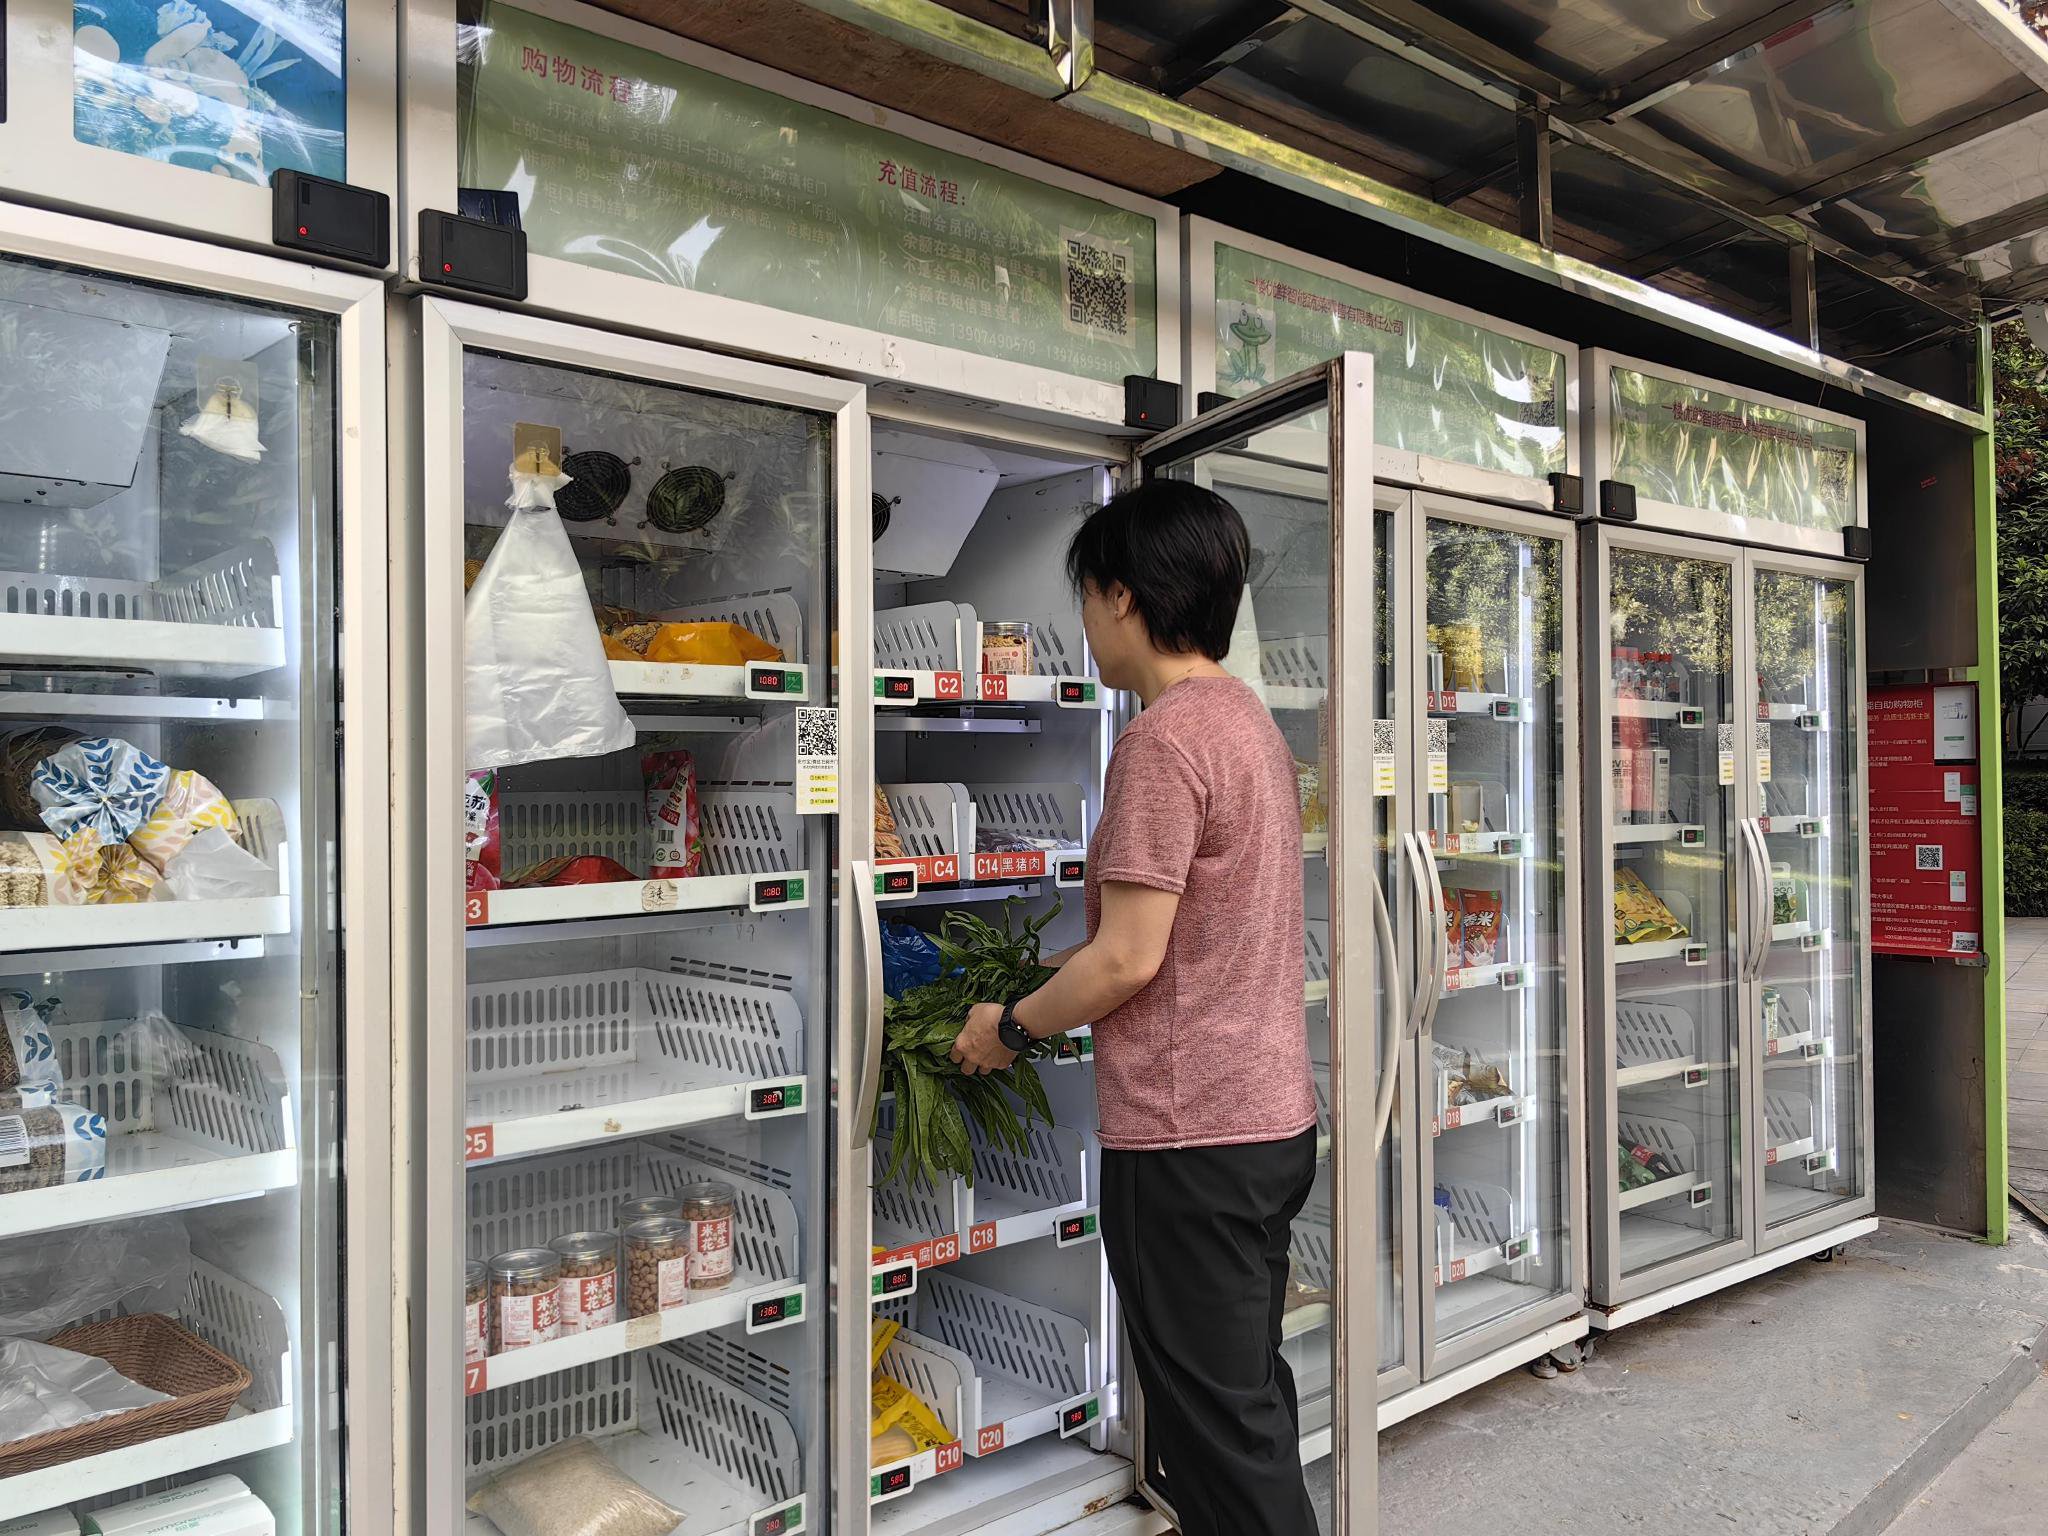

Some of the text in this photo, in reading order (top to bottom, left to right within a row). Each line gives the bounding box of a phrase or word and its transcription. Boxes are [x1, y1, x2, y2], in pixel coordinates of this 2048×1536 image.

[522, 46, 632, 104] 购物流程
[937, 677, 958, 694] C2
[984, 679, 1005, 696] C12
[1442, 696, 1457, 708] D12
[1447, 838, 1459, 850] D14
[934, 860, 955, 877] C4
[977, 857, 1040, 874] C14 黑猪肉
[467, 899, 481, 919] 3
[1447, 1111, 1460, 1125] D18
[973, 1228, 993, 1247] C18
[934, 1240, 956, 1260] C8
[1452, 1263, 1464, 1277] D20
[466, 1367, 479, 1388] 7
[980, 1430, 1001, 1450] C20
[938, 1446, 959, 1467] C10
